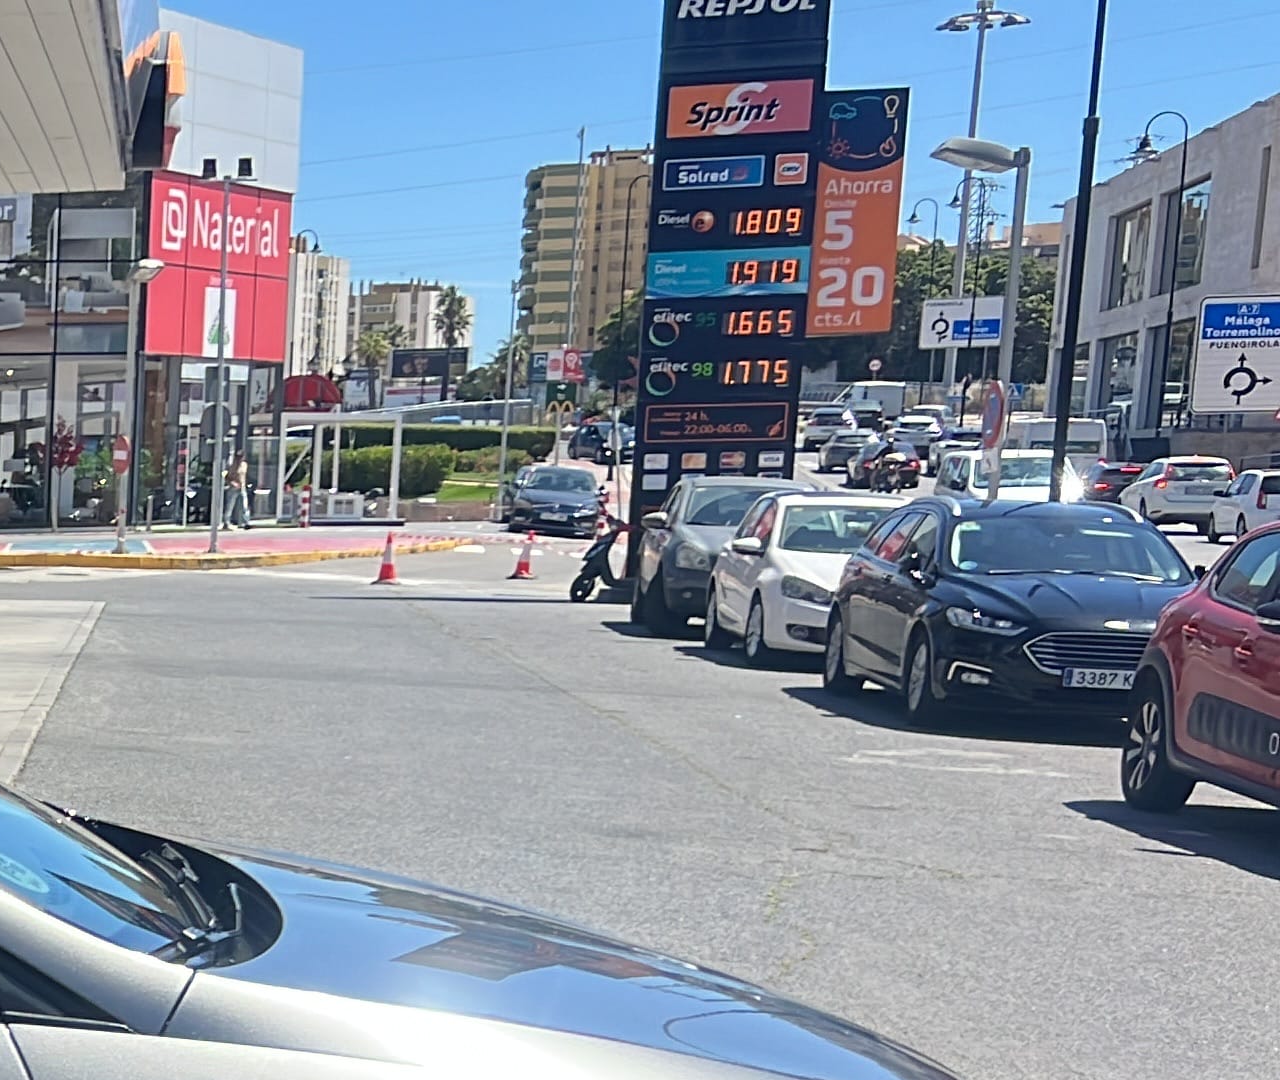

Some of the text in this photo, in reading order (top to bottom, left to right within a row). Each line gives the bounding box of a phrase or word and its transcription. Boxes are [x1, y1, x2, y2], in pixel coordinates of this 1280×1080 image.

[686, 97, 780, 131] Sprint
[678, 168, 729, 185] Solred
[825, 178, 893, 195] Ahorra
[193, 199, 279, 258] Naterial
[658, 213, 690, 225] Diesel
[735, 208, 802, 235] 1.809
[822, 210, 853, 250] 5
[731, 259, 798, 285] 1.919
[816, 266, 885, 307] 20
[695, 312, 717, 327] 95
[727, 309, 793, 335] 1.665
[1209, 340, 1280, 349] FUENGIROLA
[691, 362, 713, 378] 98
[724, 360, 789, 385] 1.775
[1076, 671, 1119, 686] 3387
